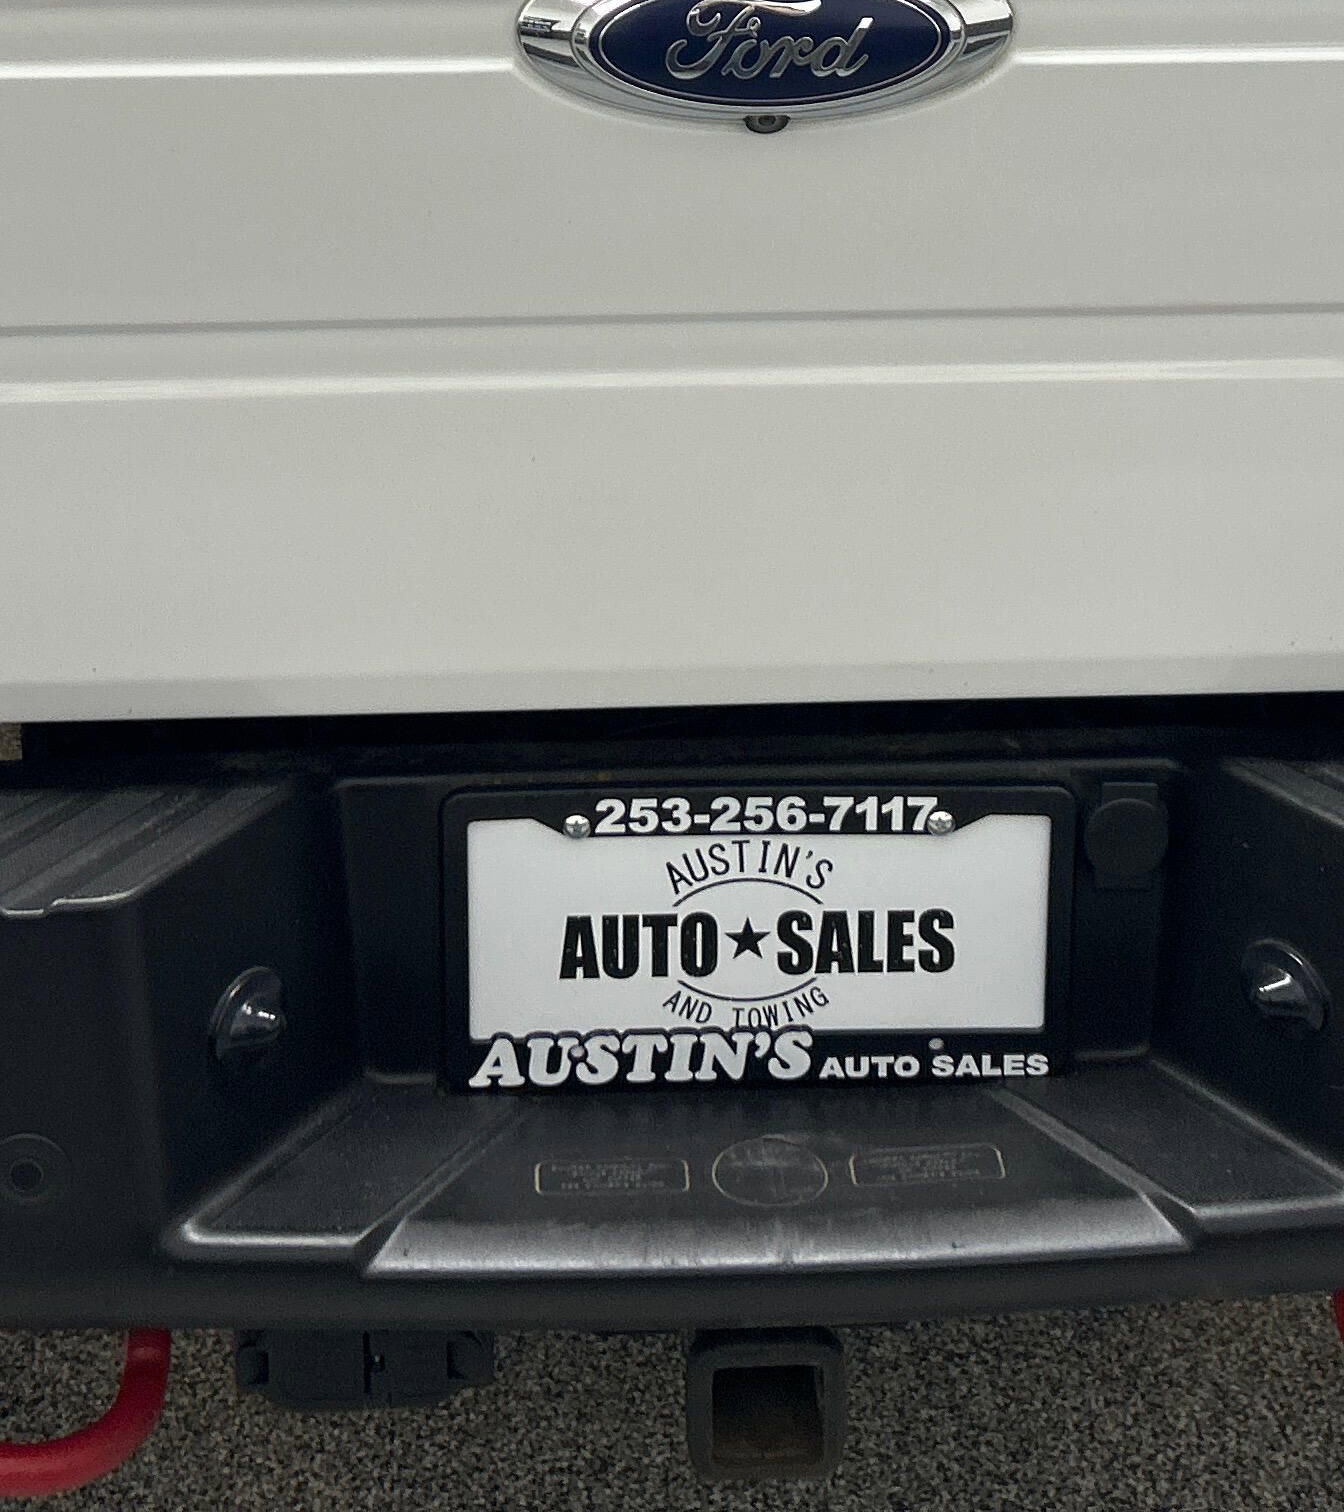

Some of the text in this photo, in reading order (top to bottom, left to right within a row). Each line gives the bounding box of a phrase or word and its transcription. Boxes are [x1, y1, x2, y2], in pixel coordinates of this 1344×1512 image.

[595, 795, 939, 834] 253-256-7117
[665, 840, 834, 895] AUSTIN'S
[559, 908, 955, 979] AUTO SALES
[662, 985, 830, 1028] AND TOWING
[469, 1031, 1050, 1088] AUSTIN'S AUTO SALES
